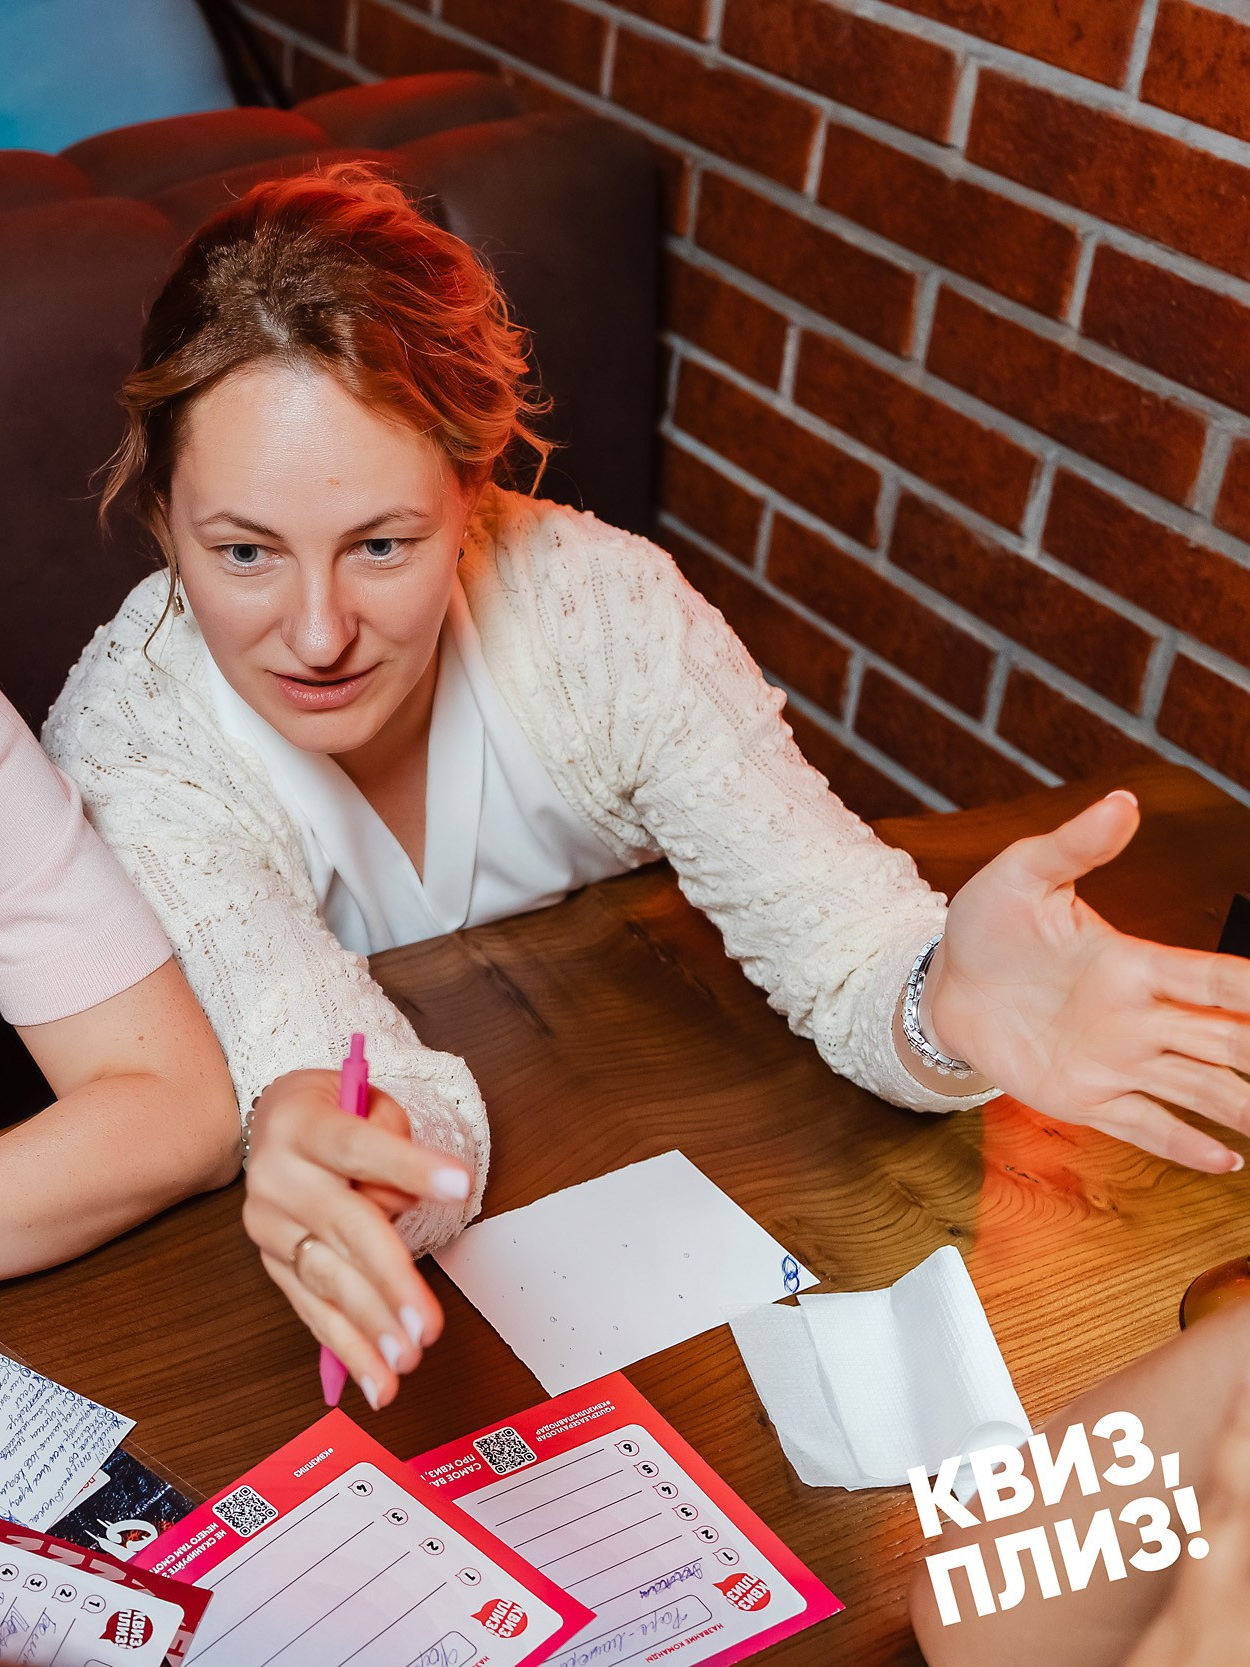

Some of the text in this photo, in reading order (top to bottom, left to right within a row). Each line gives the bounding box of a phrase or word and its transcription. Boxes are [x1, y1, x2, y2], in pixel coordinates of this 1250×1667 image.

[534, 1397, 610, 1436] #КВИЗПЛИЗПАВЛОДАР
[534, 1403, 616, 1443] #QUIZPLEASEPAVLODAR
[621, 1440, 633, 1454] 6
[292, 1445, 334, 1479] #КВИЗПЛИЗ
[422, 1450, 475, 1480] ПРО КВИЗ,
[640, 1461, 653, 1475] 5
[444, 1459, 482, 1482] САМОЕ
[355, 1482, 368, 1495] 4
[659, 1483, 672, 1497] 4
[389, 1509, 404, 1524] 3
[678, 1504, 691, 1518] 3
[188, 1521, 218, 1546] НЕЧЕГО
[213, 1527, 226, 1539] НЕ
[699, 1526, 713, 1541] 2
[172, 1541, 192, 1558] ТАМ
[426, 1539, 439, 1553] 2
[166, 1535, 217, 1575] СКАНИРУЙТЕ
[721, 1549, 733, 1562] 1
[147, 1552, 176, 1576] СМОТ
[1, 1566, 14, 1577] 4
[463, 1569, 476, 1582] 1
[29, 1578, 42, 1588] 3
[60, 1589, 72, 1598] 2
[87, 1600, 100, 1608] 1
[643, 1621, 723, 1664] НАЗВАНИЕ КОМАНДЫ
